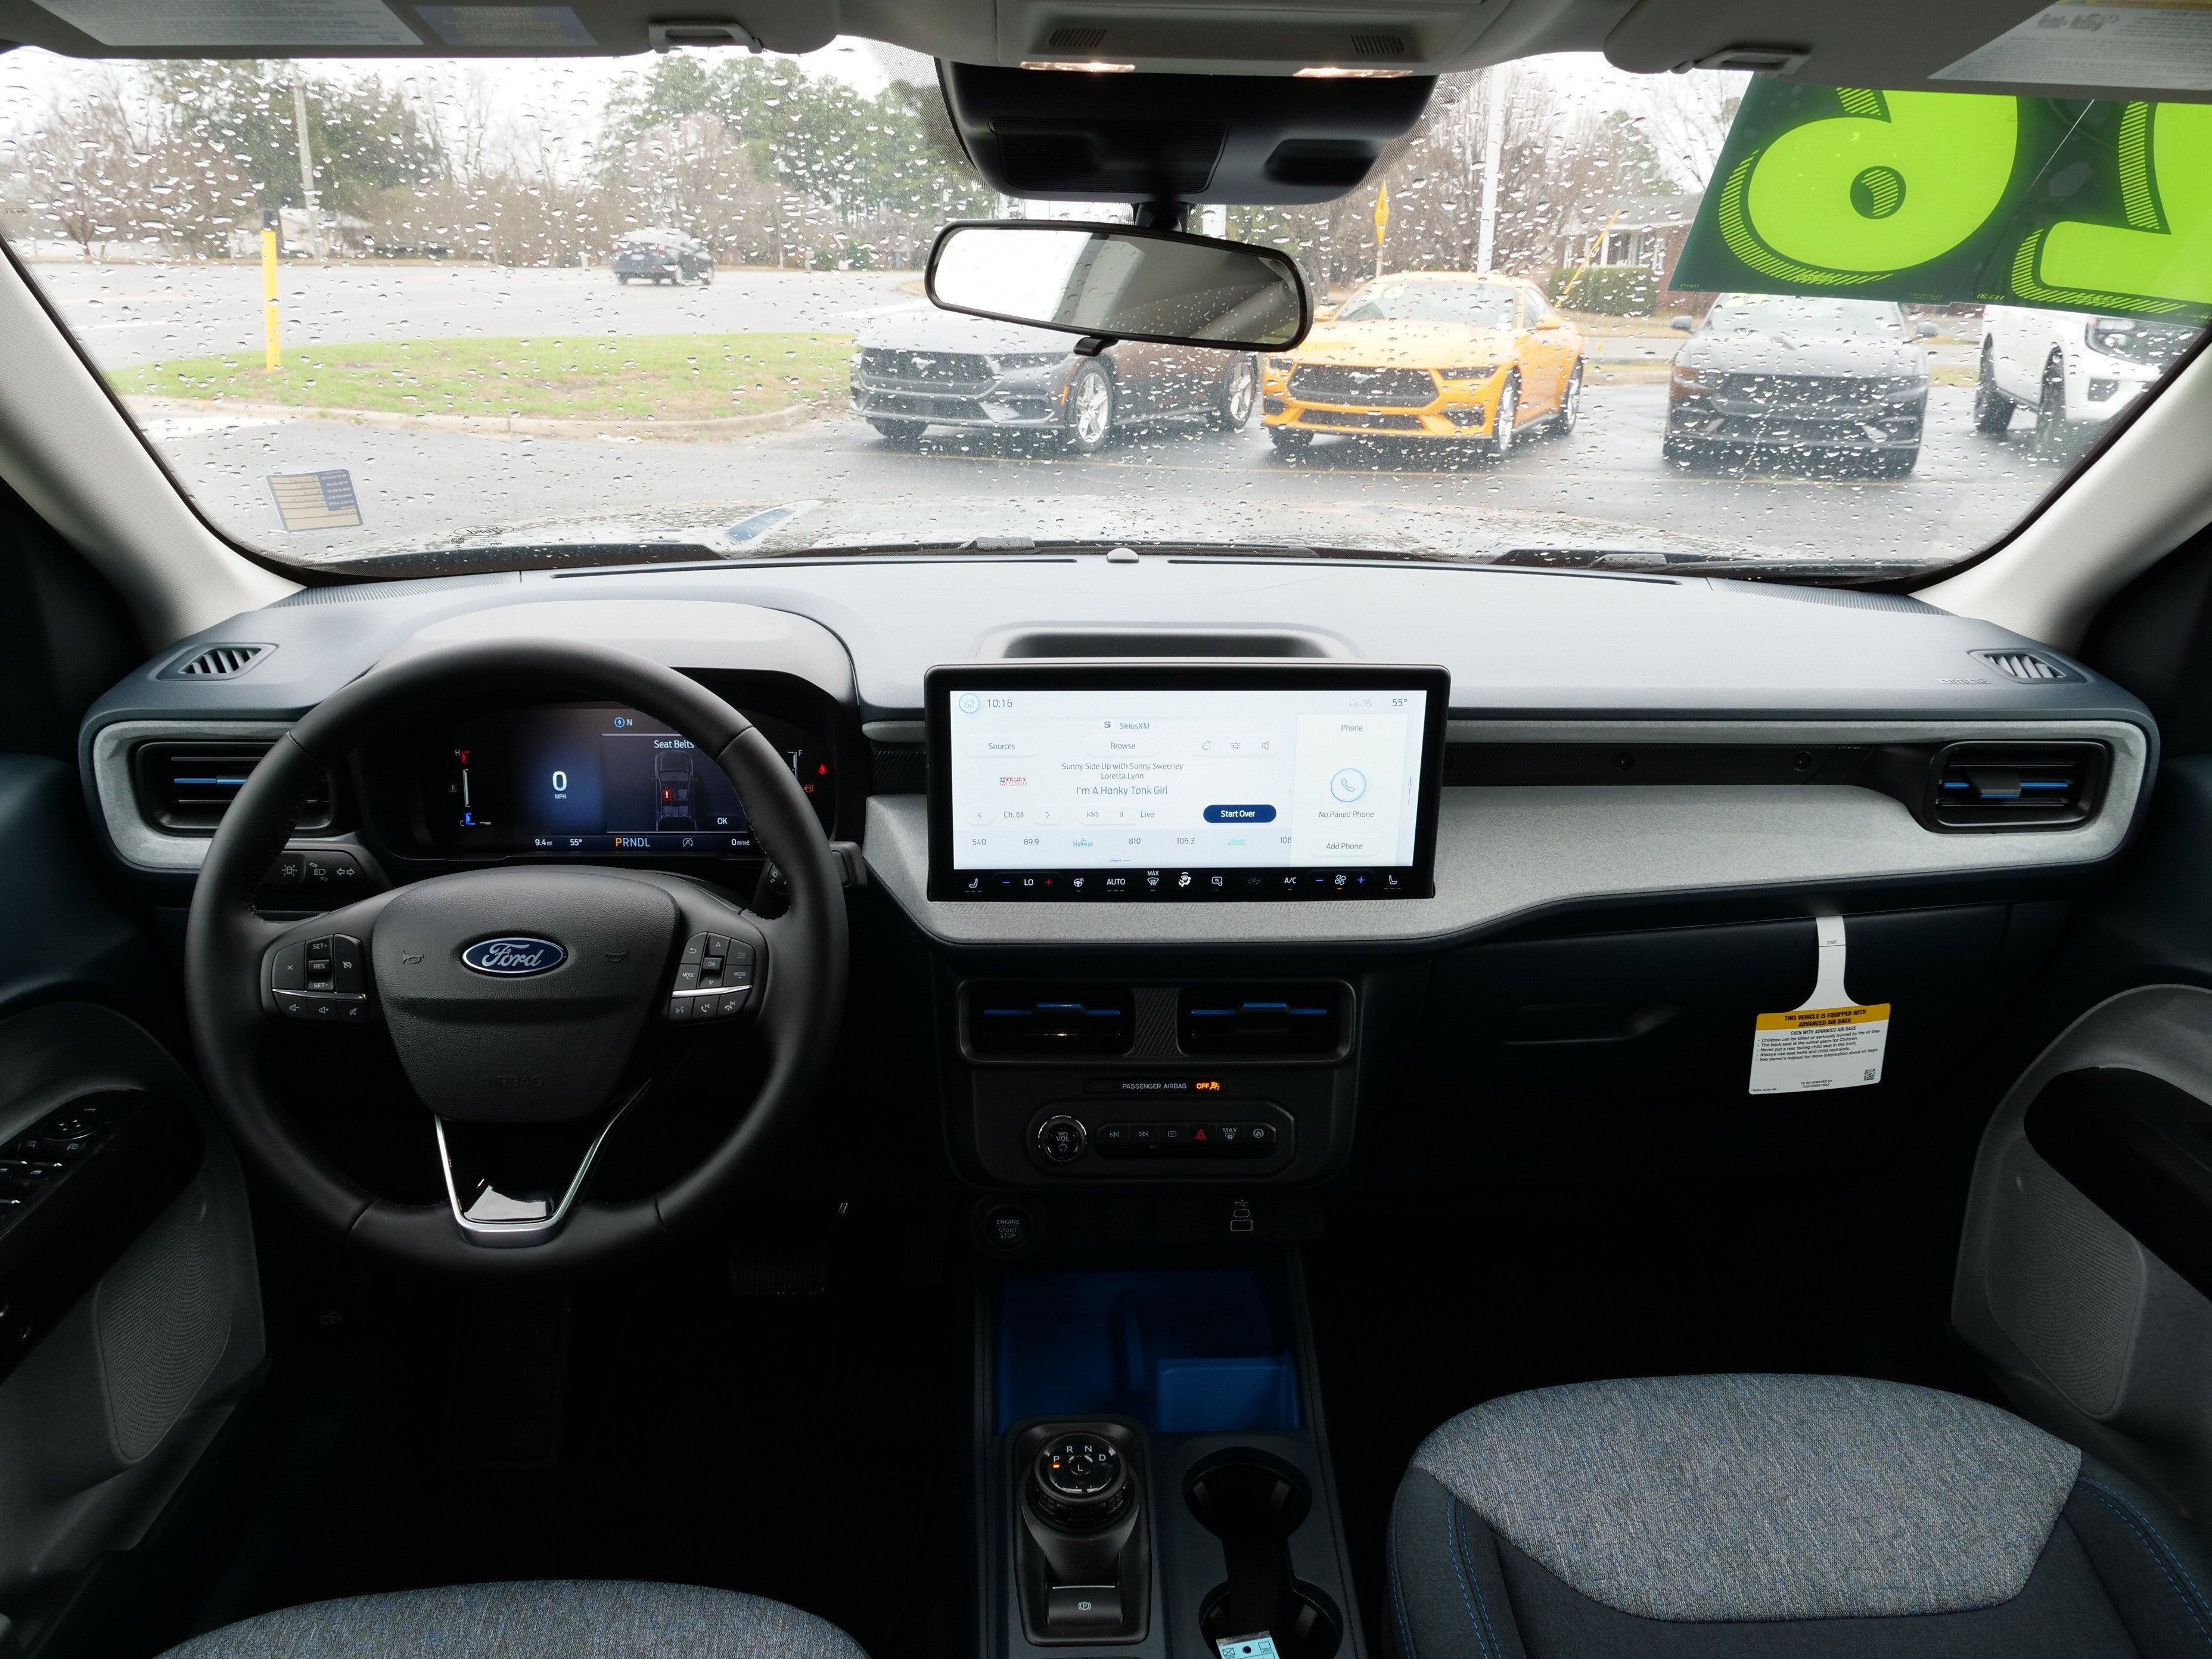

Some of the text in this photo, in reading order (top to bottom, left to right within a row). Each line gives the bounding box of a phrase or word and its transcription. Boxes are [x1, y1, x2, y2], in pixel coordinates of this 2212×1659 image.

[987, 699, 1013, 708] 10:16
[1391, 698, 1408, 707] 55°
[654, 740, 695, 748] Seat Belts
[1130, 762, 1151, 771] Sunny
[1152, 762, 1183, 771] Sweeney
[551, 771, 567, 791] 0
[1076, 785, 1168, 796] I'm A Honky Tonk Girl
[1220, 810, 1256, 818] Start Over
[481, 943, 545, 967] Ford
